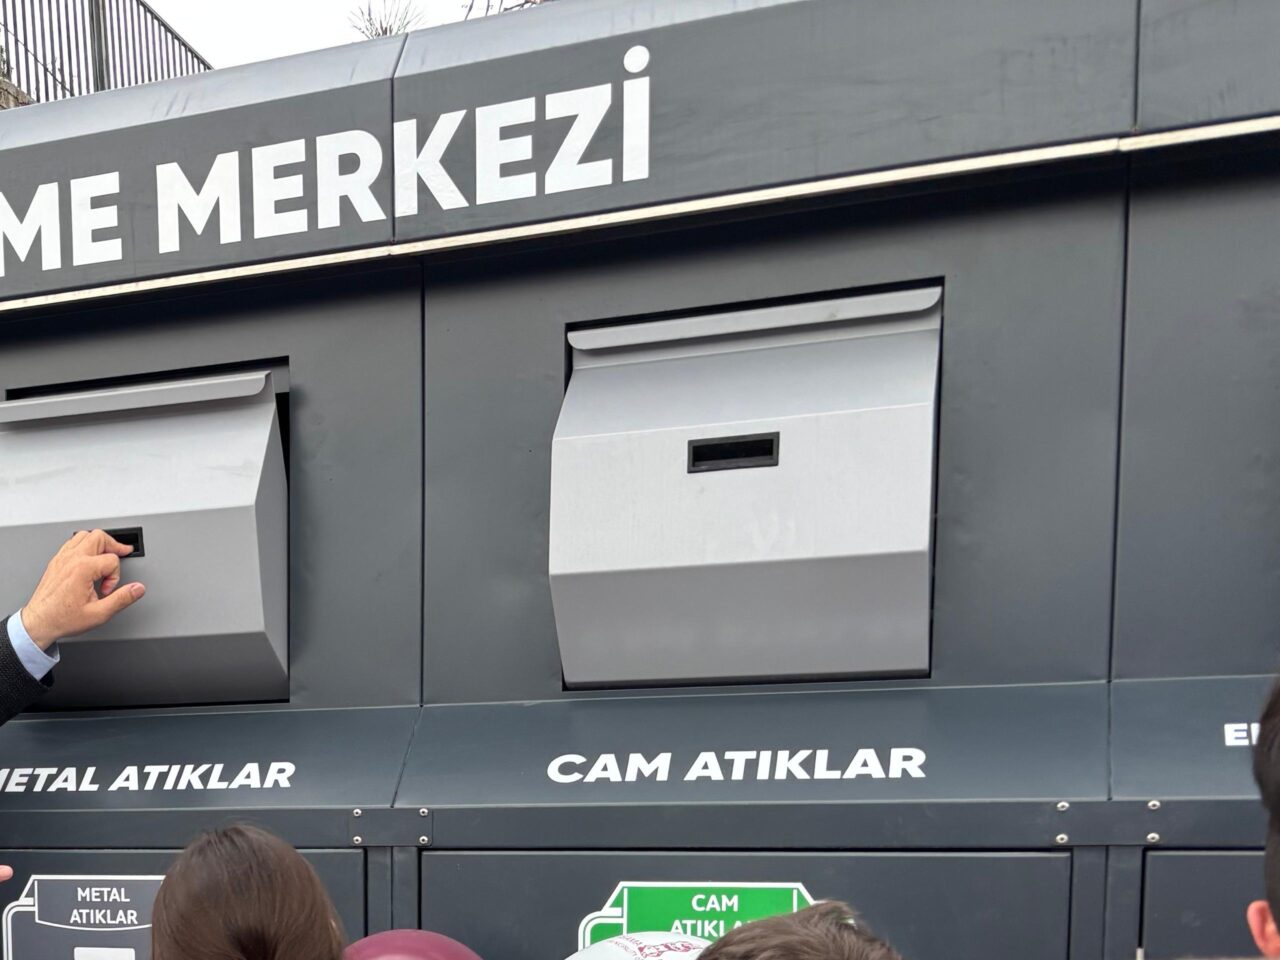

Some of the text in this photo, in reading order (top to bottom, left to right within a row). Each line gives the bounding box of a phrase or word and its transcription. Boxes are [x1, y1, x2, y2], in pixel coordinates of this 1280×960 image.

[156, 45, 651, 254] MERKEZİ
[546, 747, 927, 783] CAM ATIKLAR
[108, 761, 296, 792] ATIKLAR
[77, 887, 130, 902] METAL
[691, 894, 739, 912] CAM
[70, 909, 138, 924] ATIKLAR
[671, 919, 754, 938] ATIKL
